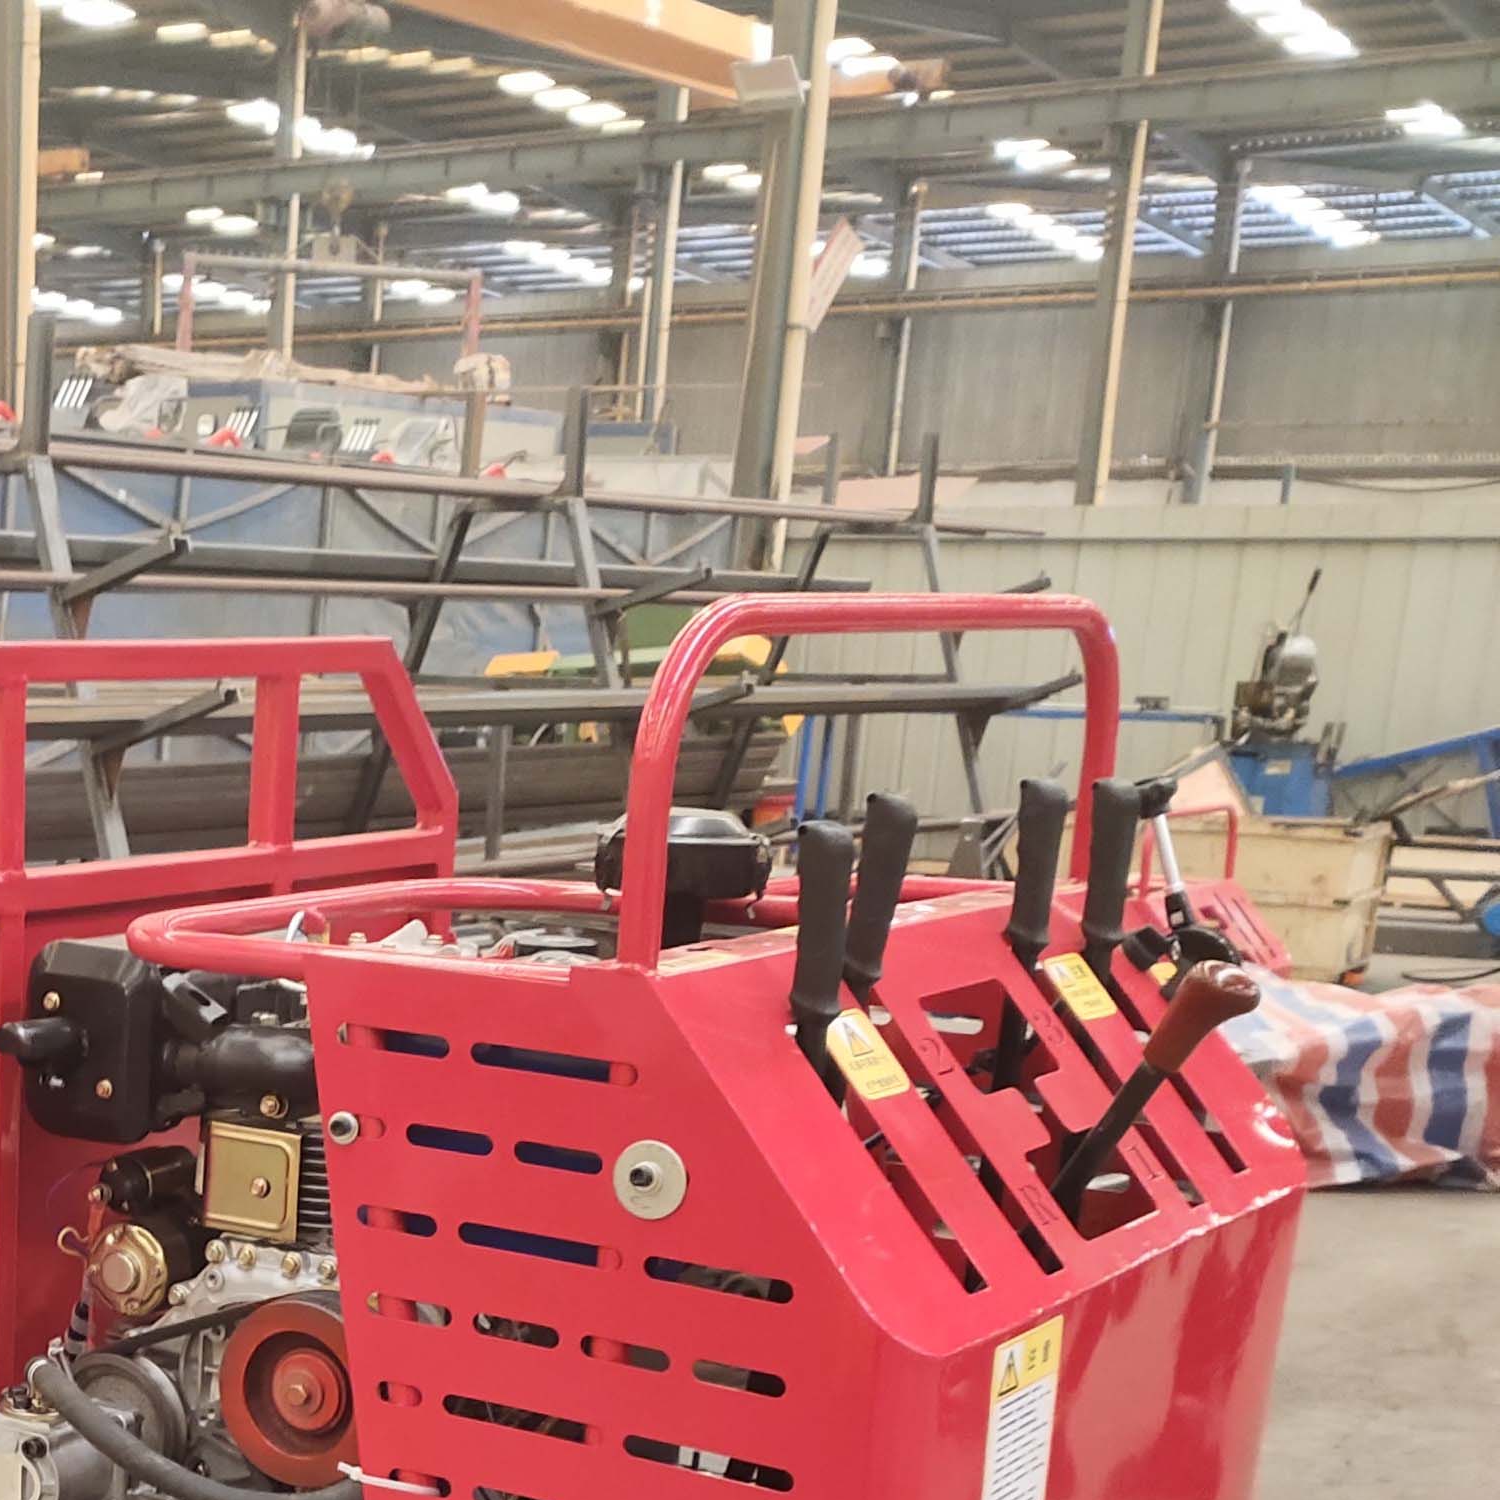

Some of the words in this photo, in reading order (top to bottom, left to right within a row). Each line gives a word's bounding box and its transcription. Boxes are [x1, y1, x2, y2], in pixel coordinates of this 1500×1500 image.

[1032, 1008, 1065, 1044] 3
[917, 1037, 954, 1076] 2
[1017, 1184, 1059, 1226] R
